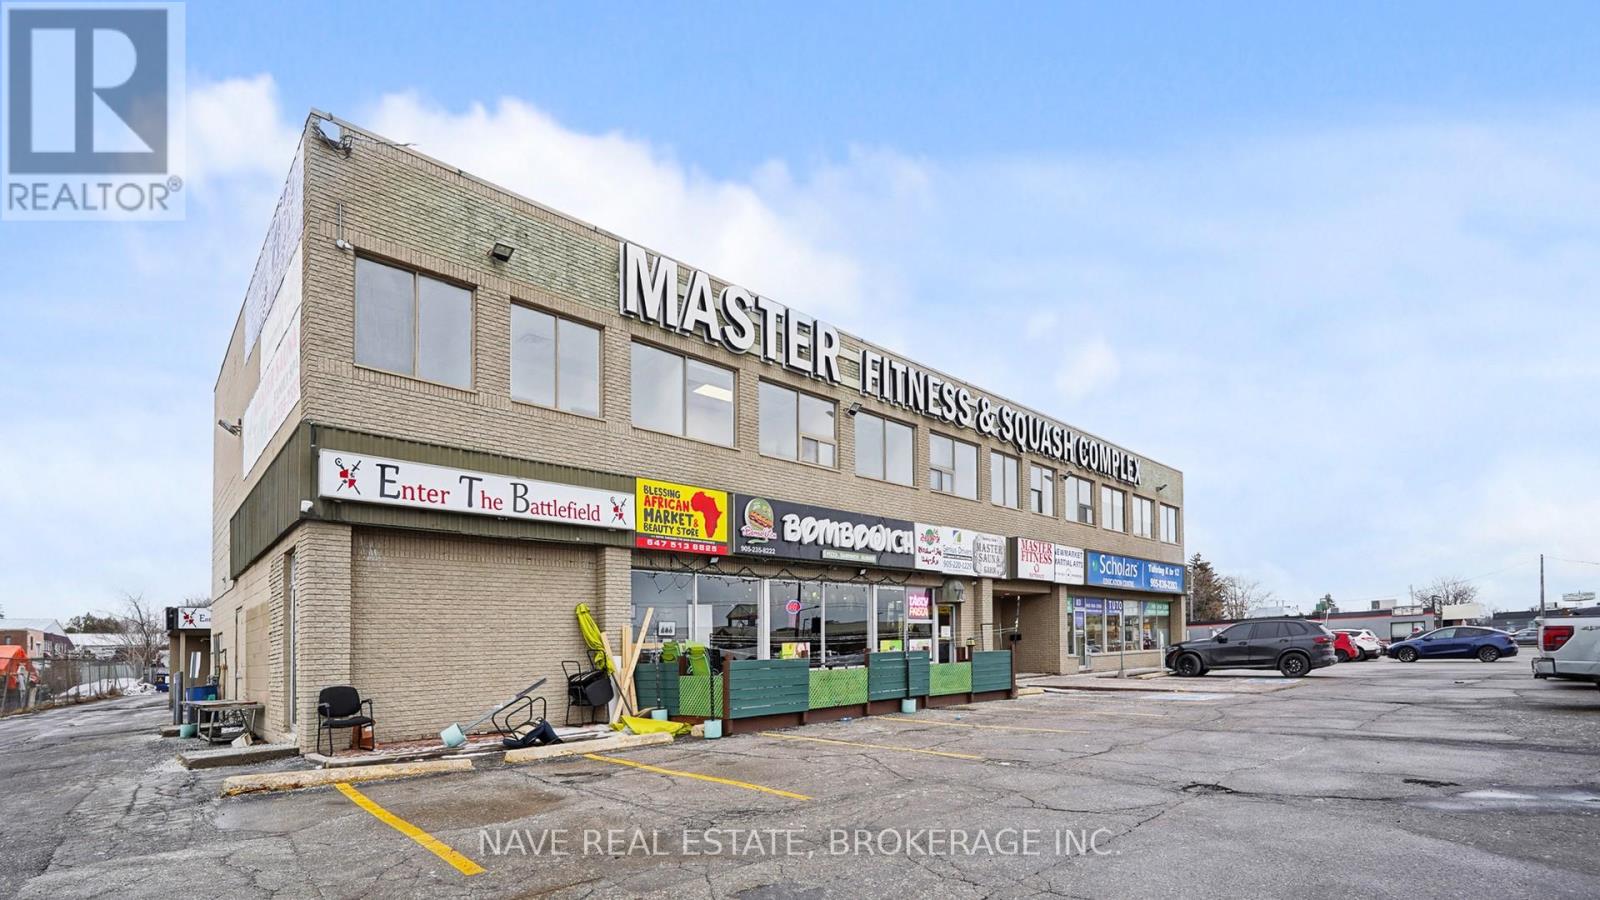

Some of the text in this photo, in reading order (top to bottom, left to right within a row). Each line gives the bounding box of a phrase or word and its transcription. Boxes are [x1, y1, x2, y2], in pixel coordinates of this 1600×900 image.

[619, 241, 1142, 488] MASTER FITNESS & SQUASH COMPLEX
[376, 463, 601, 522] Enter The Battlefield
[643, 485, 680, 499] BLESSING
[644, 495, 690, 512] AFRICAN
[643, 508, 699, 528] MARKET &
[643, 523, 699, 537] BEAUTY STORE
[977, 542, 1003, 555] MASTER
[1021, 539, 1052, 554] MASTER
[979, 553, 1000, 564] SAUNA
[1021, 550, 1053, 565] FITNESS
[1100, 554, 1138, 577] Scholars
